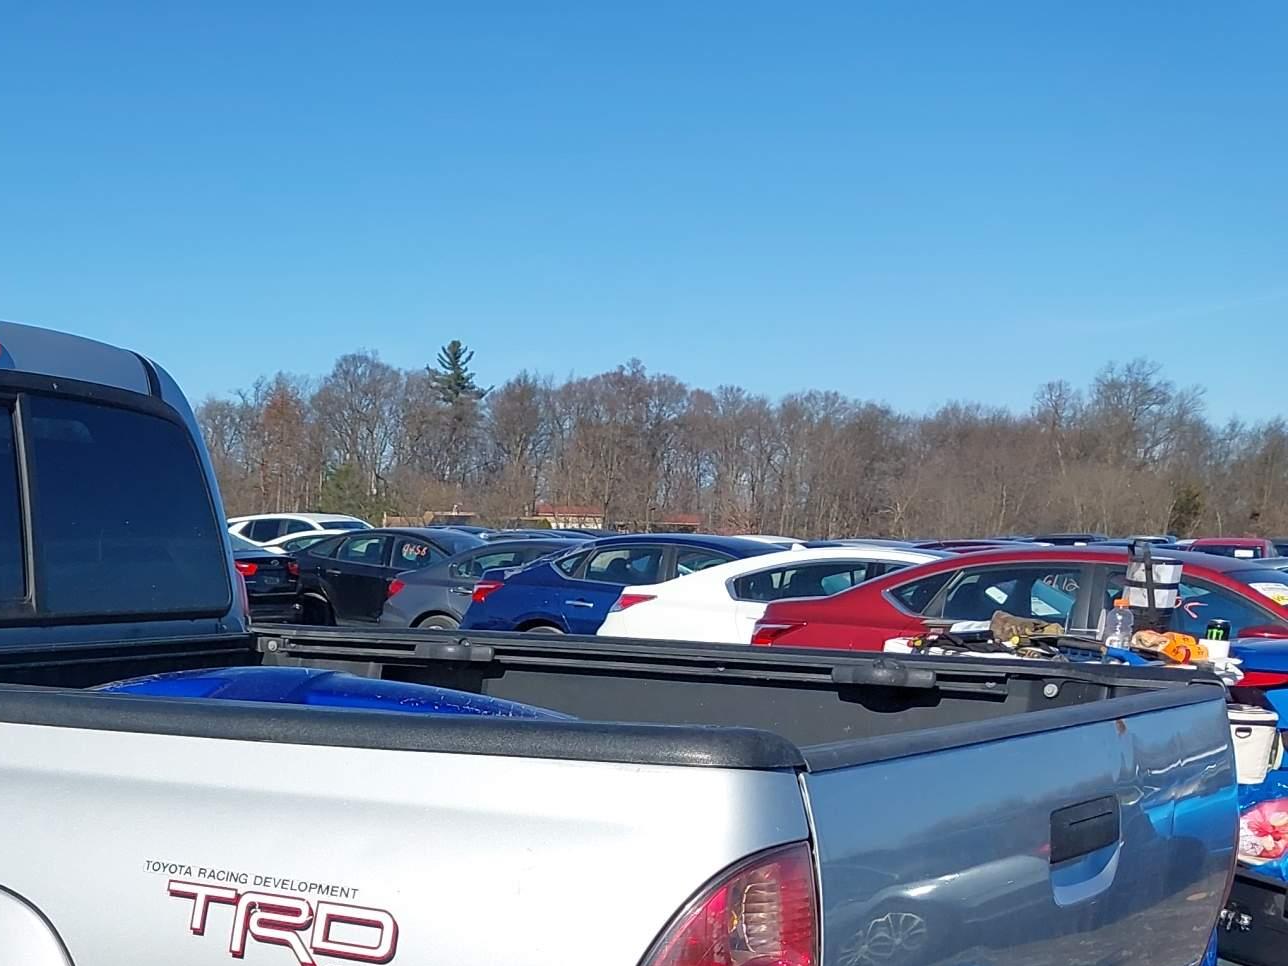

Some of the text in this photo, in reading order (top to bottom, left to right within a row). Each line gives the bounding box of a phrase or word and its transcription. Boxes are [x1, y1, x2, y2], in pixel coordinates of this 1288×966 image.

[145, 860, 360, 899] TOYOTA RACING DEVELOPMENT
